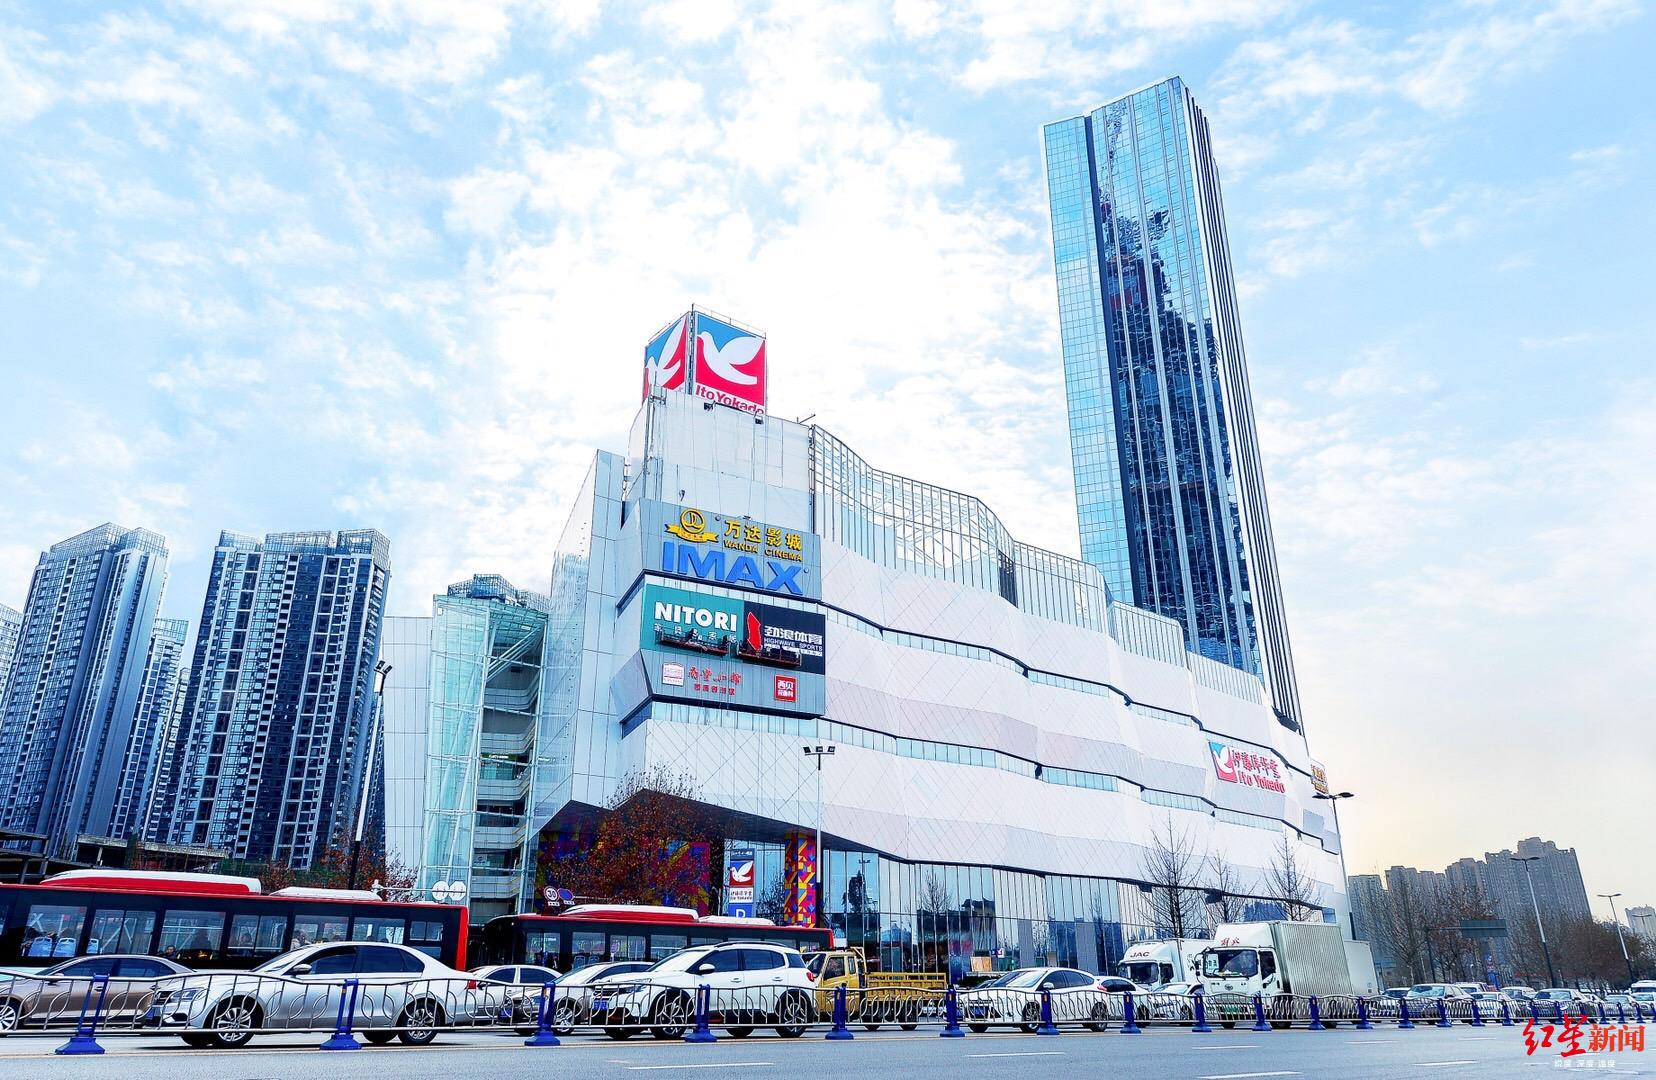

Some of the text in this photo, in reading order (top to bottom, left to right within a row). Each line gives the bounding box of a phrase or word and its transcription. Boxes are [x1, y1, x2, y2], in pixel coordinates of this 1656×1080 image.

[695, 384, 715, 401] Ito
[724, 520, 802, 550] 万达影城
[723, 540, 803, 562] WANDA CINEMA
[662, 541, 804, 596] IMAX
[654, 601, 738, 633] NITORI
[764, 625, 823, 645] 劲浪体育
[764, 637, 796, 648] HIGHWAVE
[799, 643, 823, 652] SPORTS
[777, 679, 794, 691] 西贝
[1231, 750, 1281, 779] 伊藤洋华堂
[1238, 770, 1286, 793] Ito Yokado
